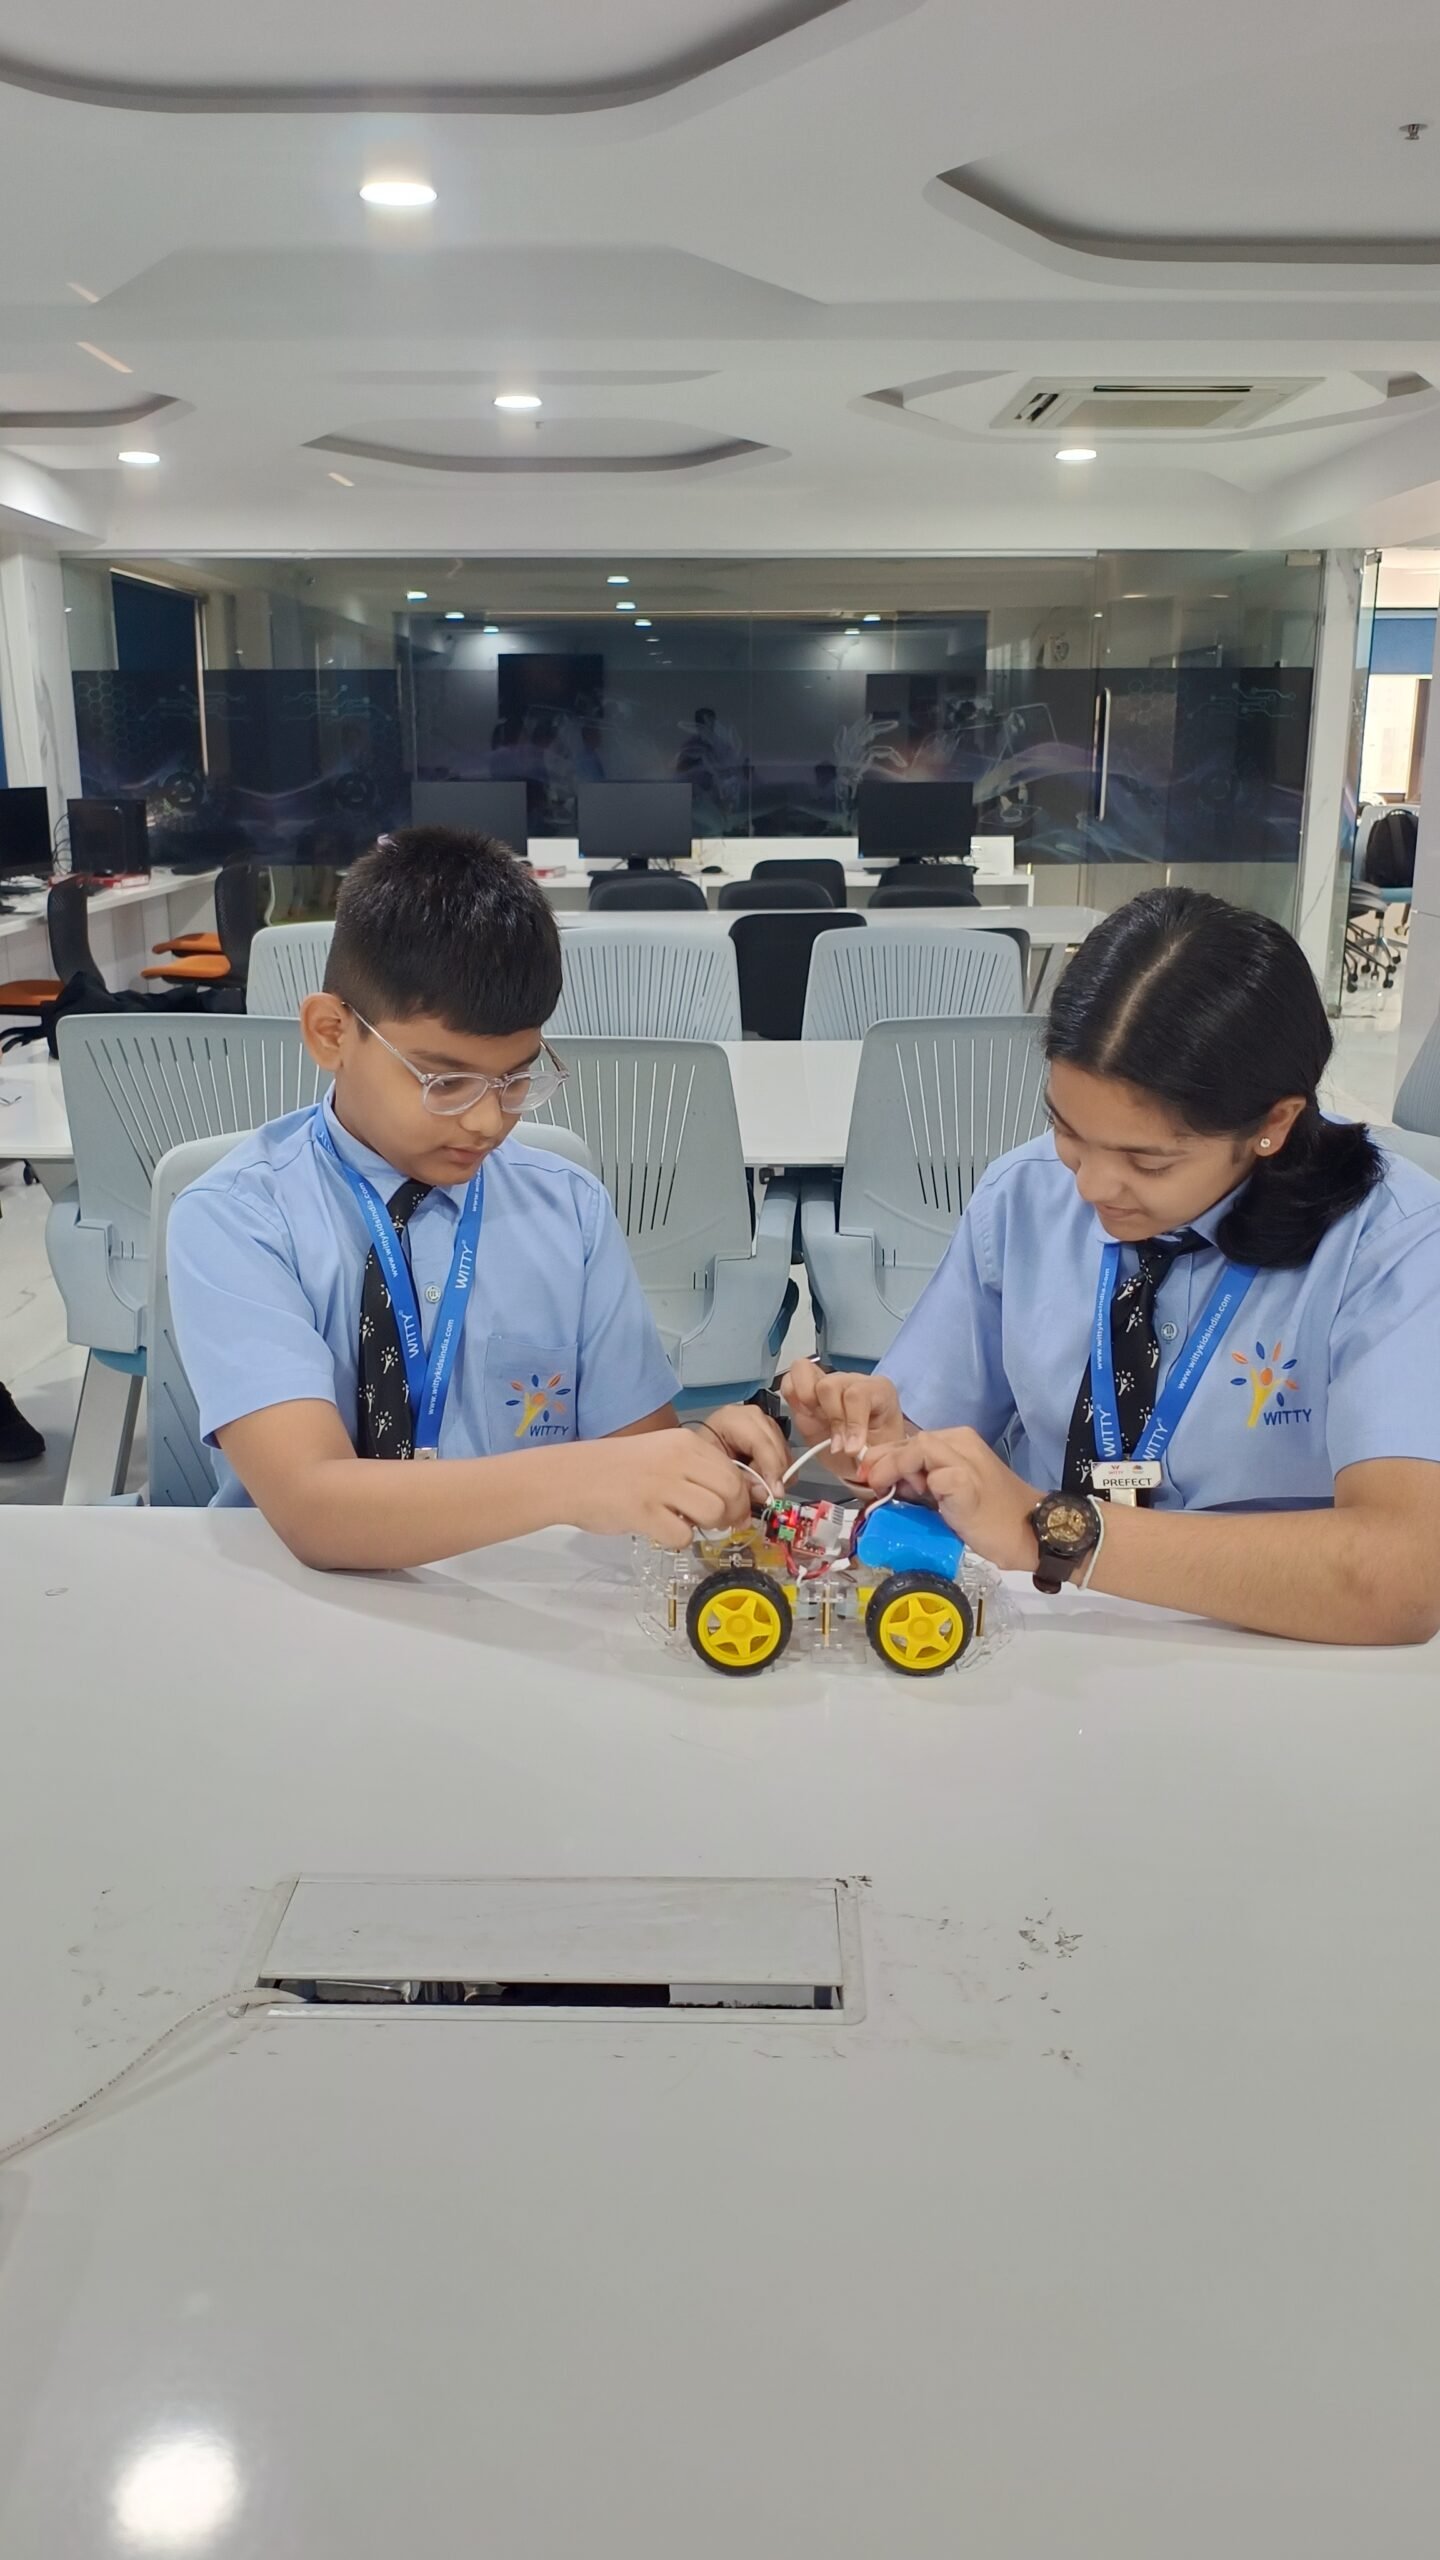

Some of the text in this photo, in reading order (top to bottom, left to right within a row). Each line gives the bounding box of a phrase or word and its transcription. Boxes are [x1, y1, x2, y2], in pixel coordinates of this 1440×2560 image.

[359, 1182, 398, 1278] www.wittykidsindia.com
[454, 1244, 473, 1289] WITTY
[401, 1314, 419, 1358] WITTY
[1178, 1293, 1232, 1390] www.wittykidsindia.com
[428, 1319, 455, 1416] www.wittykidsindia.com
[530, 1425, 569, 1437] WITTY
[1099, 1409, 1116, 1457] WITTY
[1263, 1408, 1312, 1426] WITTY
[1102, 1478, 1152, 1487] PREFECT
